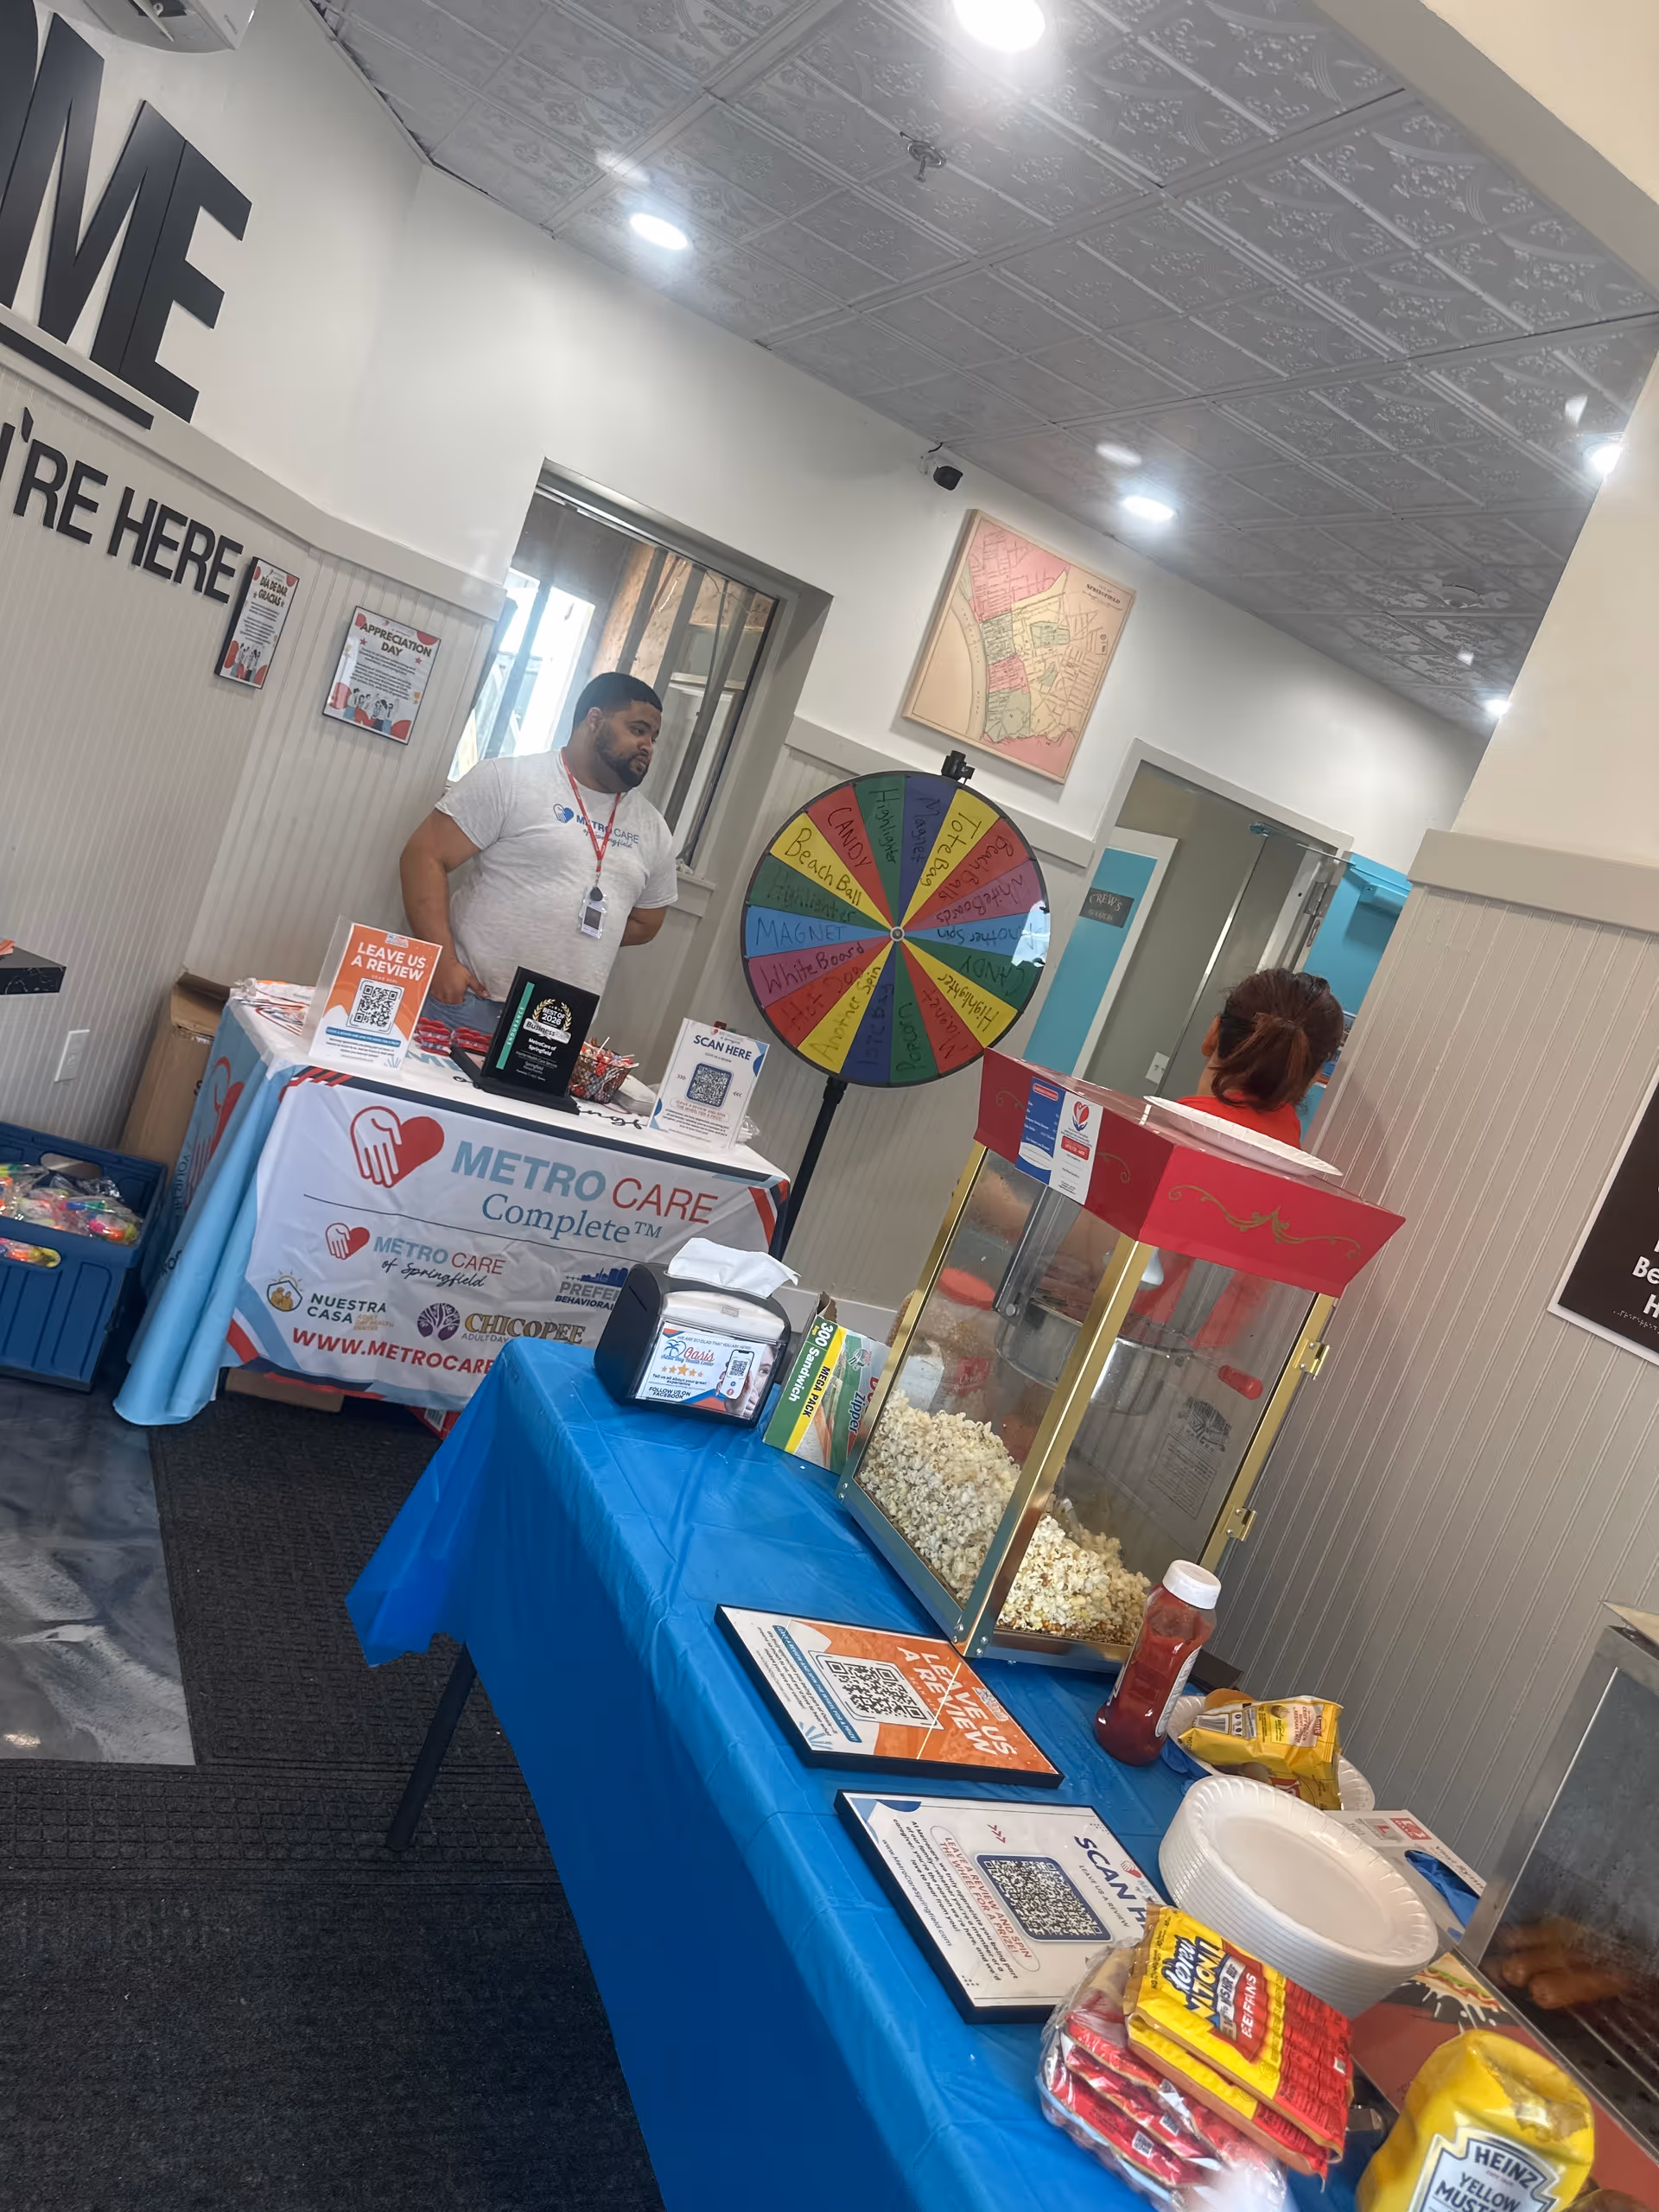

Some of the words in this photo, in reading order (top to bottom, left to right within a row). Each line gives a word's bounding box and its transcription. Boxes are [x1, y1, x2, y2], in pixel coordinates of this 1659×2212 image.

[0, 2, 252, 423] ME
[107, 486, 244, 604] HERE
[359, 623, 432, 657] APPRECIATION
[381, 642, 403, 657] DAY
[613, 828, 639, 843] CARE
[827, 807, 873, 868] CANDY
[868, 787, 899, 865] Highlighter
[910, 796, 941, 862] Magnet
[785, 827, 834, 887] Beach
[835, 870, 862, 907] Ball
[755, 917, 847, 945] MAGNET
[351, 955, 362, 968] A
[366, 957, 424, 982] REVIEW
[358, 942, 406, 964] LEAVE
[408, 952, 427, 969] US
[541, 1013, 562, 1026] 2026
[543, 1007, 557, 1017] BEST
[557, 1011, 565, 1020] OF
[938, 974, 1000, 1033] Highlighter
[693, 1034, 724, 1052] SCAN
[726, 1044, 752, 1061] HERE
[451, 1140, 606, 1202] METRO
[612, 1177, 719, 1224] CARE
[373, 1236, 448, 1265] METRO
[451, 1252, 506, 1275] CARE
[381, 1257, 398, 1274] of
[401, 1262, 487, 1288] Springfield
[307, 1306, 353, 1324] CASA
[310, 1293, 387, 1313] NUESTRA
[464, 1313, 587, 1344] CHICOPEE
[814, 1322, 834, 1348] 300
[683, 1346, 714, 1362] Oasis
[788, 1346, 820, 1403] Sandwich
[649, 1385, 673, 1394] FOLLOW
[652, 1390, 683, 1400] FACEBOOK
[814, 1365, 831, 1392] MEGA
[802, 1392, 817, 1419] PACK
[849, 1390, 866, 1434] Zipper
[896, 1646, 921, 1662] A
[914, 1669, 995, 1753] REVIEW
[922, 1653, 987, 1719] LEAVE
[981, 1726, 1016, 1754] US
[1072, 1836, 1137, 1899] SCAN
[910, 1834, 919, 1844] our
[971, 1926, 993, 1956] member
[911, 1859, 922, 1872] love
[925, 1882, 937, 1897] hear
[936, 1898, 948, 1914] from
[945, 1916, 959, 1931] you!
[939, 1842, 954, 1857] THE
[952, 1860, 975, 1888] WHEEL
[973, 1892, 989, 1910] FOR
[994, 1923, 1018, 1952] PRIZE!
[944, 1837, 967, 1863] LEAVE
[970, 1874, 998, 1909] REVIEW
[995, 1912, 1014, 1933] AND
[1011, 1936, 1032, 1957] SPIN
[1078, 1865, 1096, 1883] LEAVE
[1095, 1885, 1104, 1894] US
[1107, 1902, 1128, 1927] REVIEW
[927, 1872, 937, 1882] the
[935, 1884, 952, 1906] reason
[976, 1947, 988, 1961] and
[938, 1862, 947, 1872] we
[945, 1872, 957, 1888] truly
[956, 1889, 982, 1925] appreciate
[980, 1927, 992, 1940] you
[990, 1942, 1006, 1961] being
[1002, 1962, 1017, 1978] part
[1474, 2145, 1538, 2190] HEINZ
[1434, 2180, 1497, 2212] MUST
[1459, 2171, 1522, 2212] YELLOW
